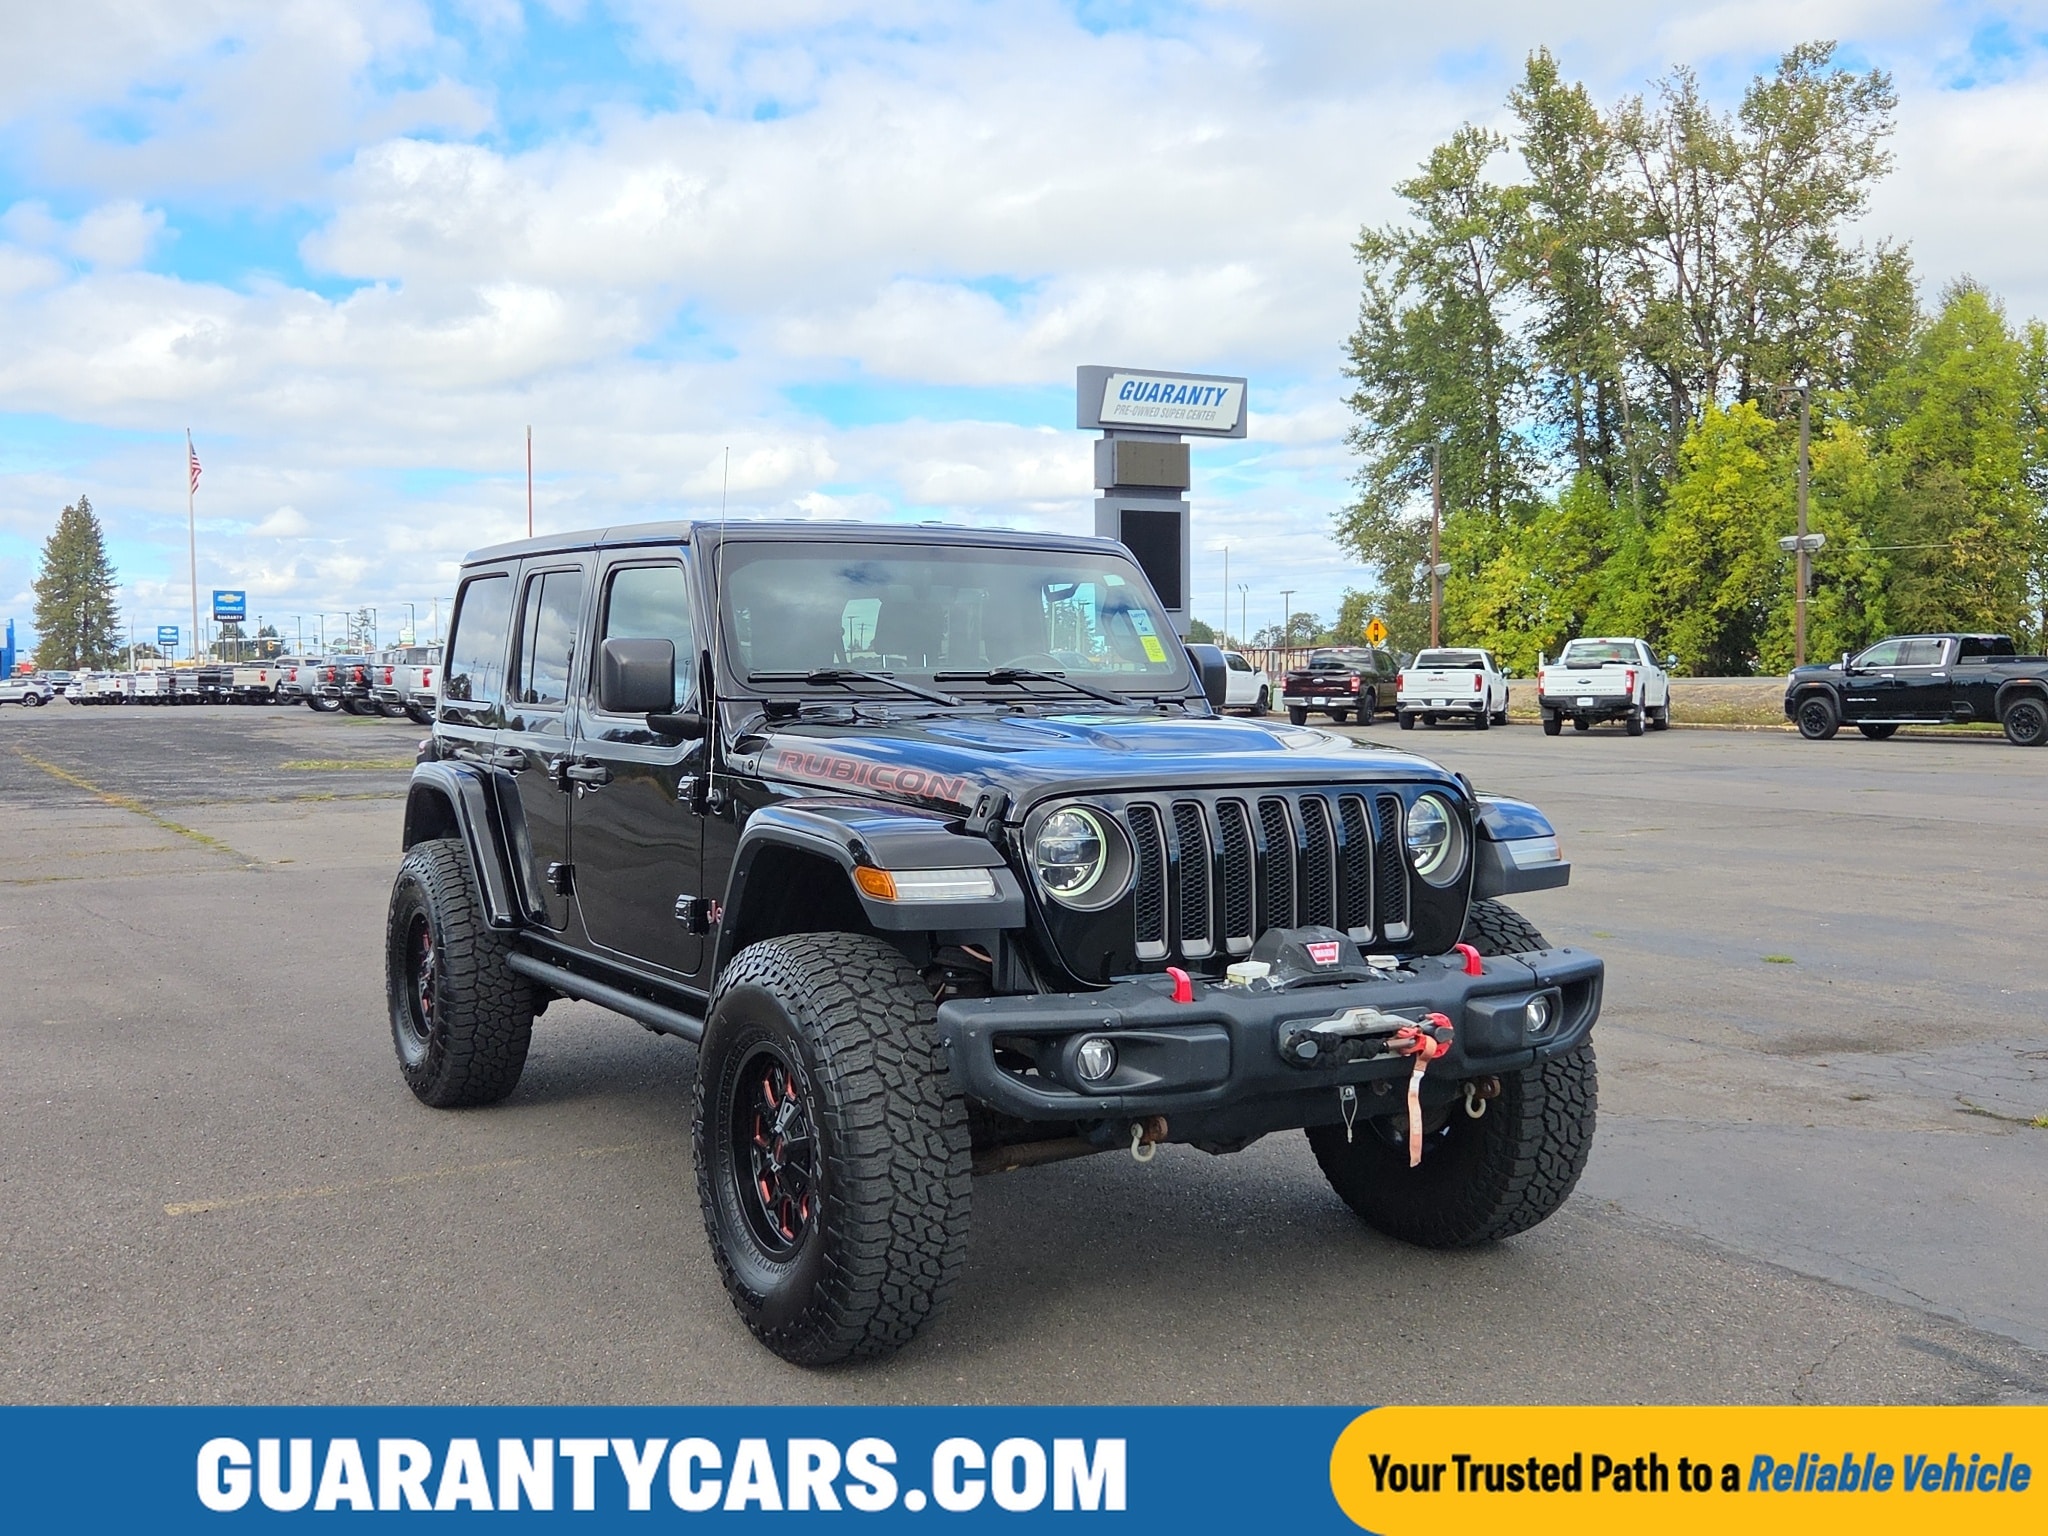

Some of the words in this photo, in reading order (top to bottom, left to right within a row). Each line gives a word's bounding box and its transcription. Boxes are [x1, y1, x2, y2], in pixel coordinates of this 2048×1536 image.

[1119, 380, 1229, 407] GUARANTY
[1113, 404, 1160, 419] PRE-OWNED
[1160, 408, 1186, 420] SUPER
[1185, 409, 1217, 422] CENTER
[776, 750, 967, 802] RUBICON
